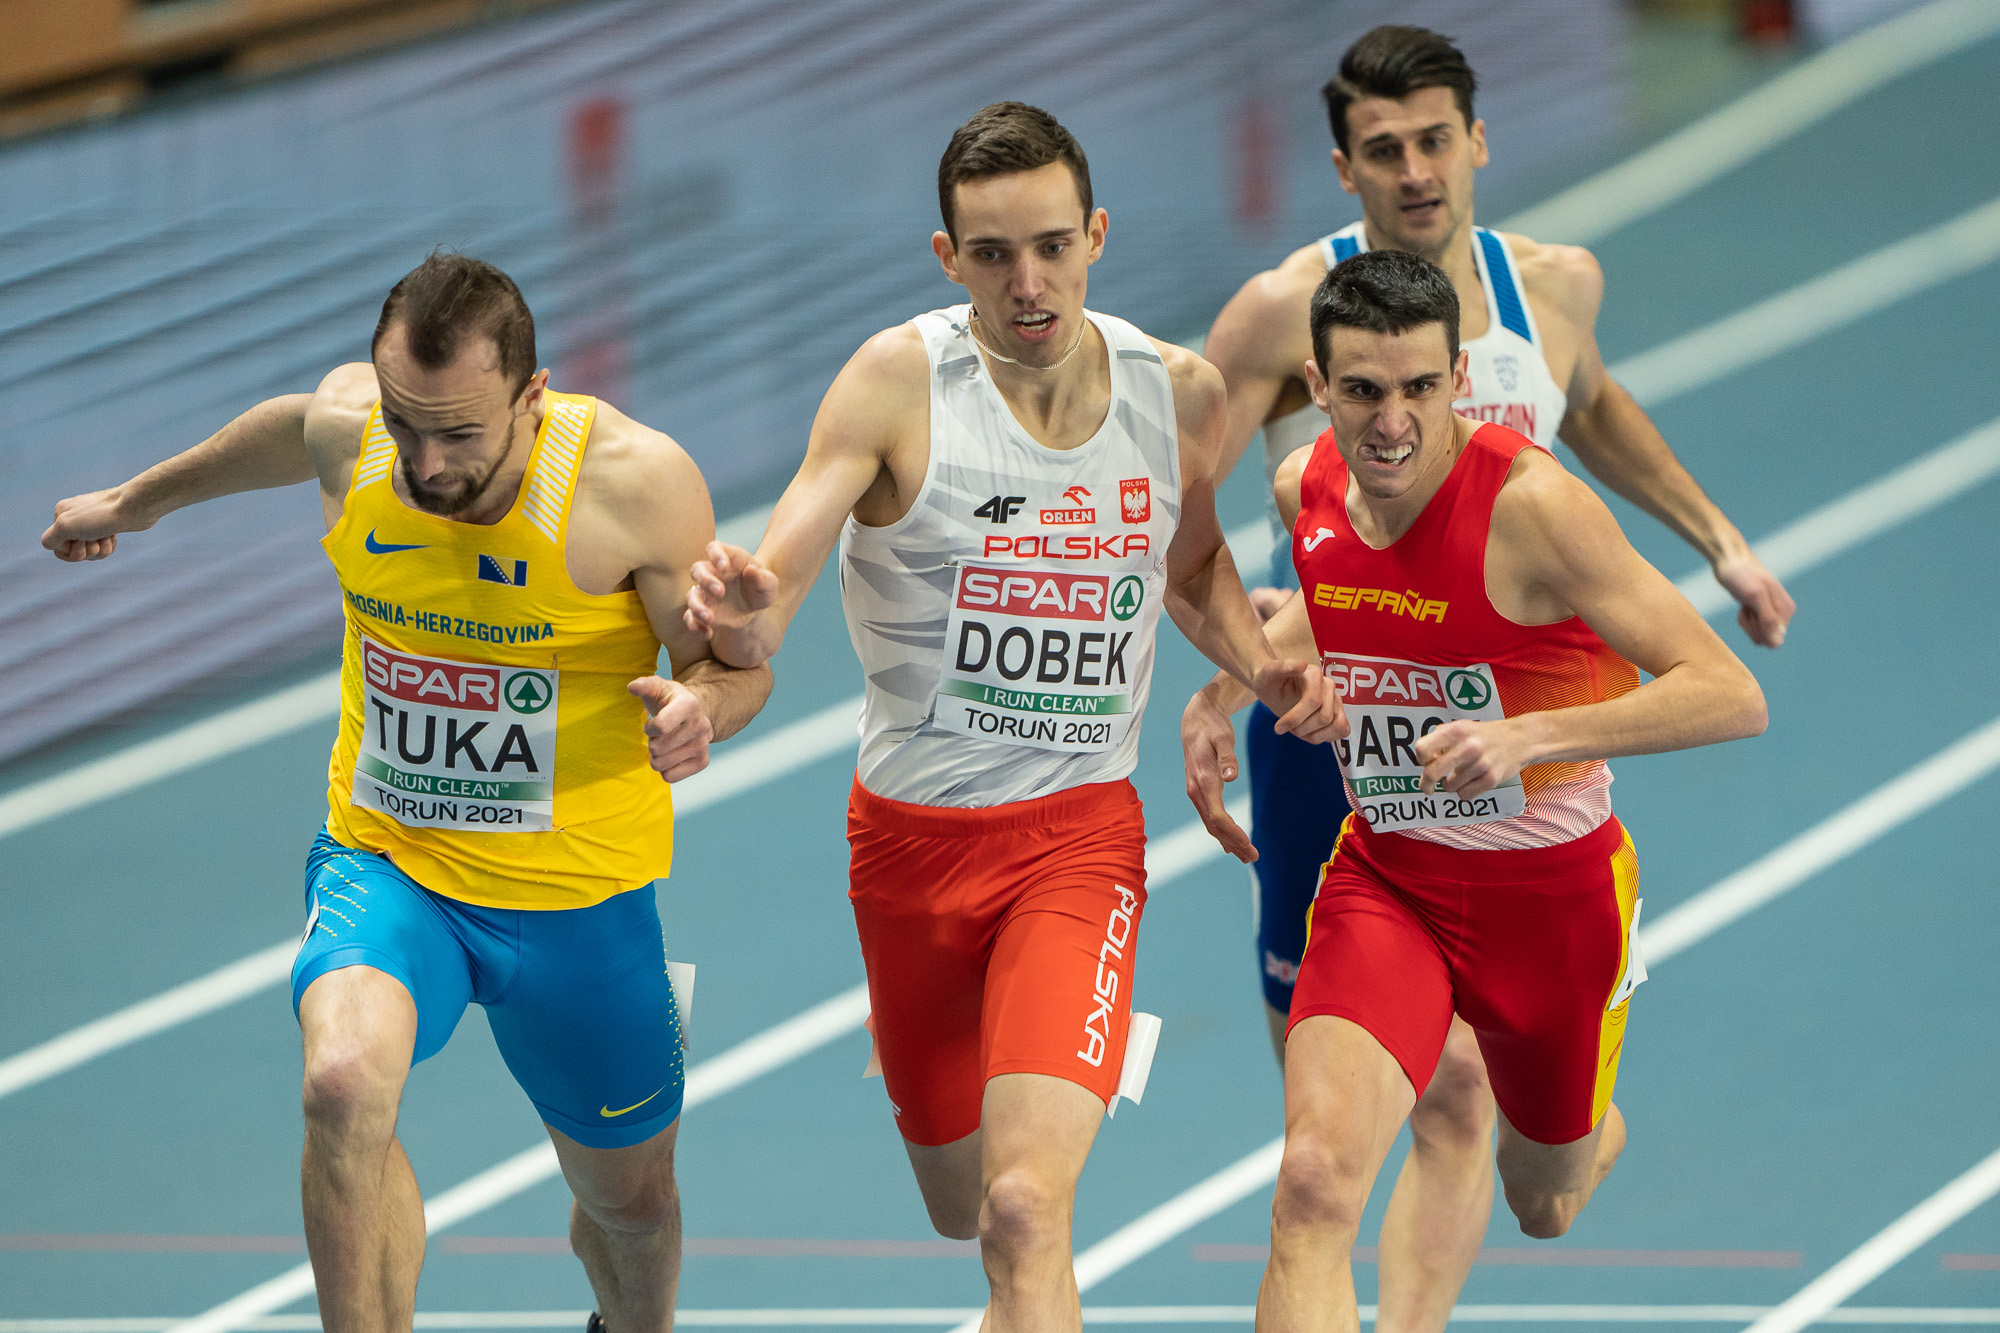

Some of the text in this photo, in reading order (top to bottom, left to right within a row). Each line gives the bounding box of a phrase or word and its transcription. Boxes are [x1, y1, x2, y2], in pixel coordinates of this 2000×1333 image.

[1121, 479, 1148, 488] POLSKA
[973, 495, 1027, 524] 4F
[1042, 510, 1093, 523] ORLEN
[983, 534, 1150, 560] POLSKA
[962, 573, 1105, 615] SPAR
[1313, 582, 1449, 624] ESPAÑA
[347, 589, 555, 645] BOSNIA-HERZEGOVINA
[955, 620, 1133, 686] DOBEK
[366, 650, 495, 705] SPAR
[1325, 664, 1442, 702] SPAR
[983, 687, 989, 701] I
[994, 690, 1035, 709] RUN
[371, 694, 539, 774] TUKA
[965, 707, 1112, 744] TORUŃ 2021
[1333, 714, 1481, 768] GAR
[386, 767, 391, 784] I
[393, 772, 432, 792] RUN
[1366, 778, 1406, 794] RUN
[374, 786, 523, 825] TORUŃ 2021
[1363, 796, 1500, 826] ORUŃ 2021
[1077, 883, 1138, 1068] POLSKA
